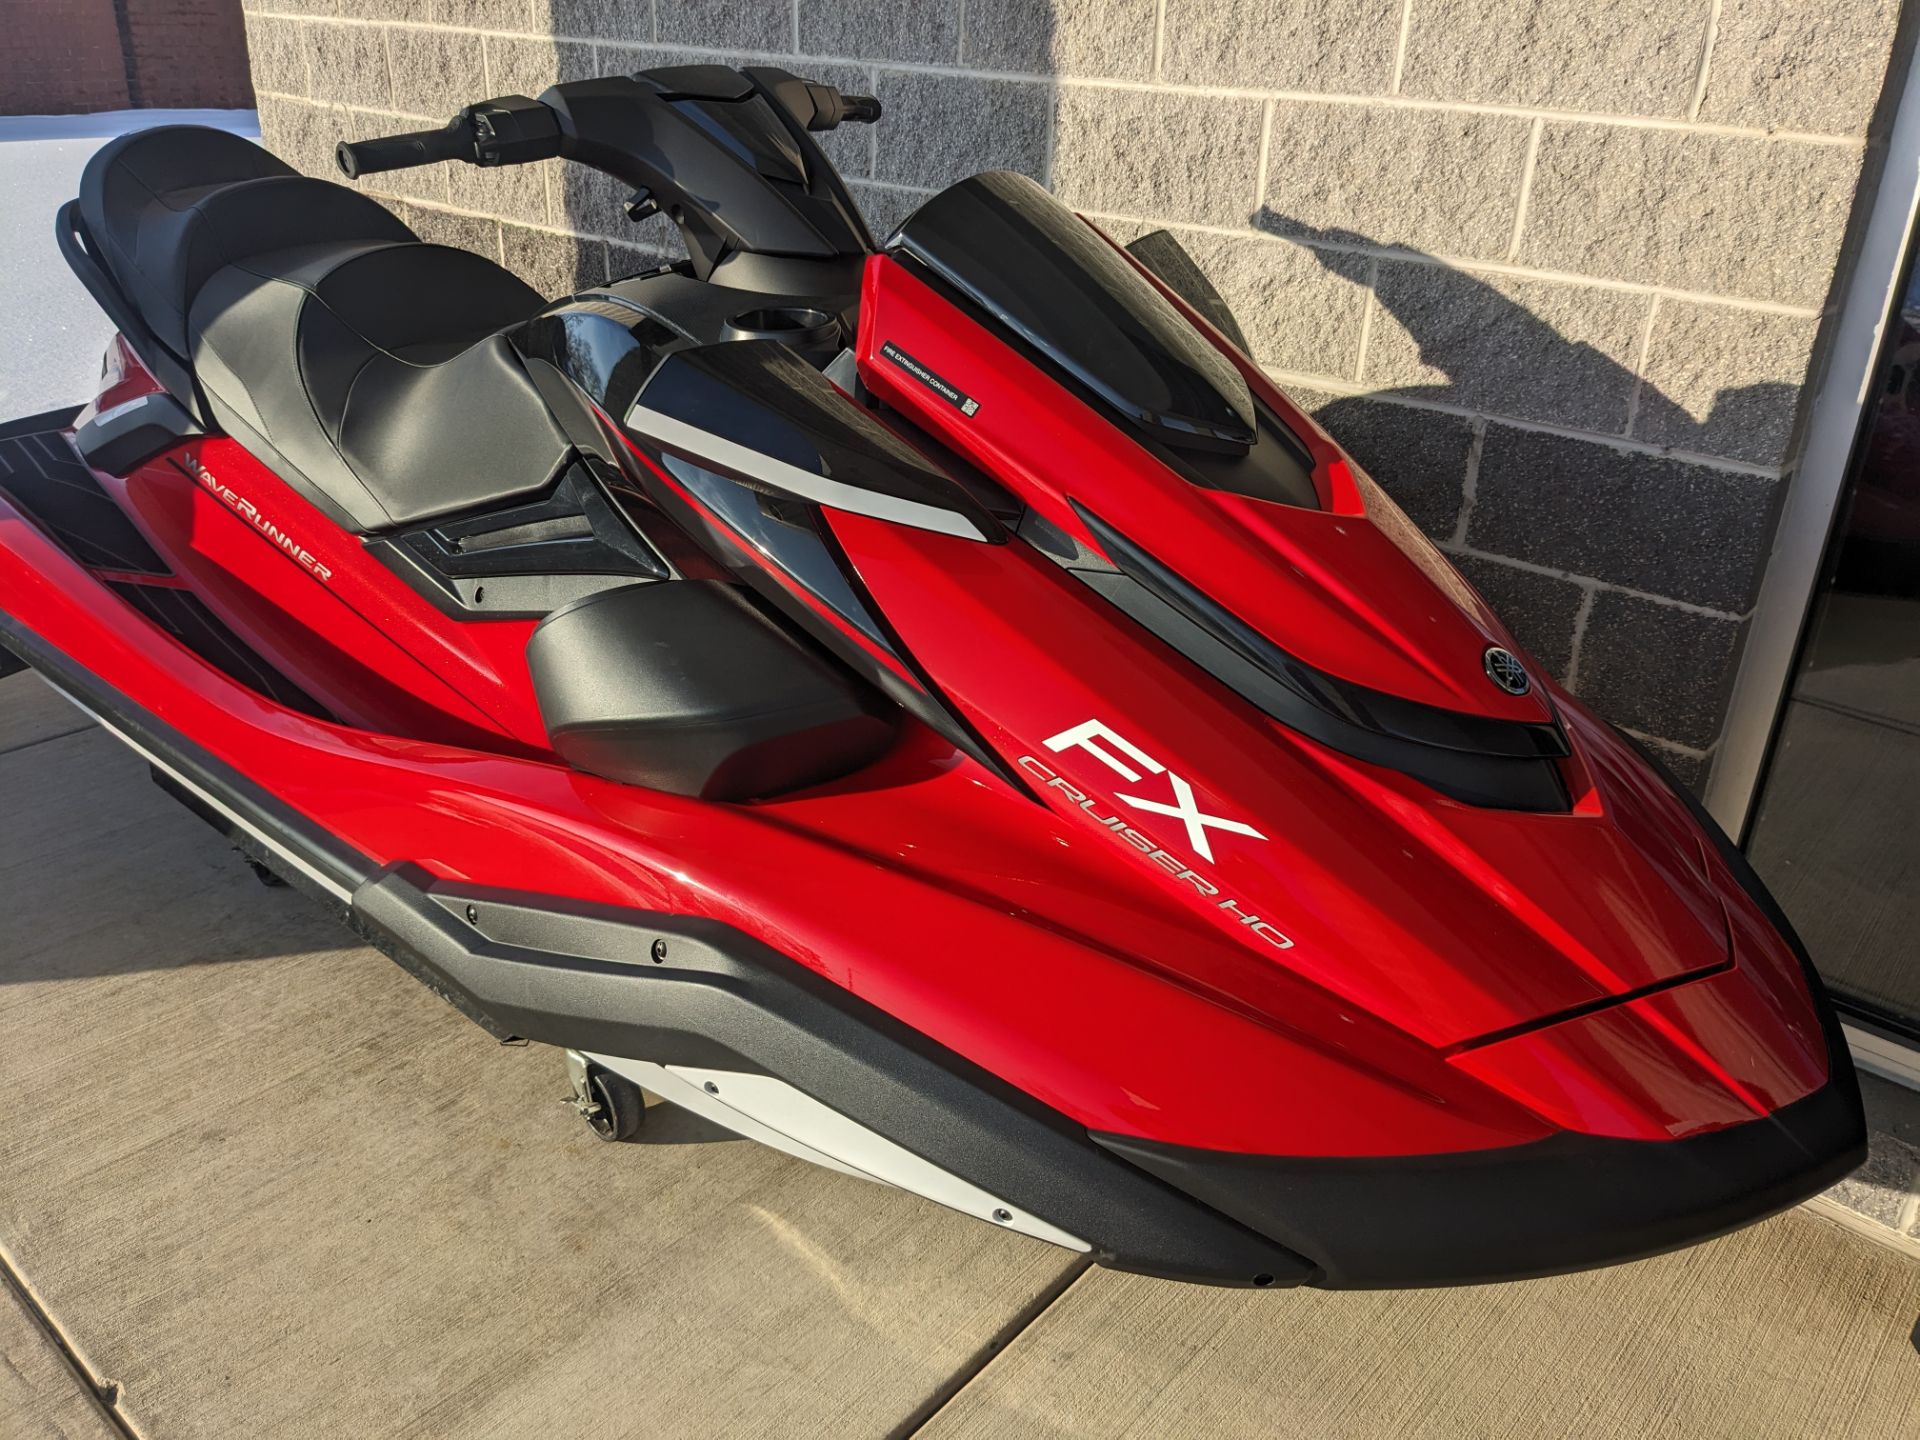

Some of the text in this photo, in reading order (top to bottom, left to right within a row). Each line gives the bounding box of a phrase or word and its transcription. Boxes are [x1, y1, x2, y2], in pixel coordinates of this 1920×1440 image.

[883, 345, 958, 401] FIRE EXTINGUISHER CONTAINER
[184, 452, 332, 581] WAVERUNNER
[1018, 756, 1295, 950] CRUISER HO
[1042, 719, 1270, 865] FX
